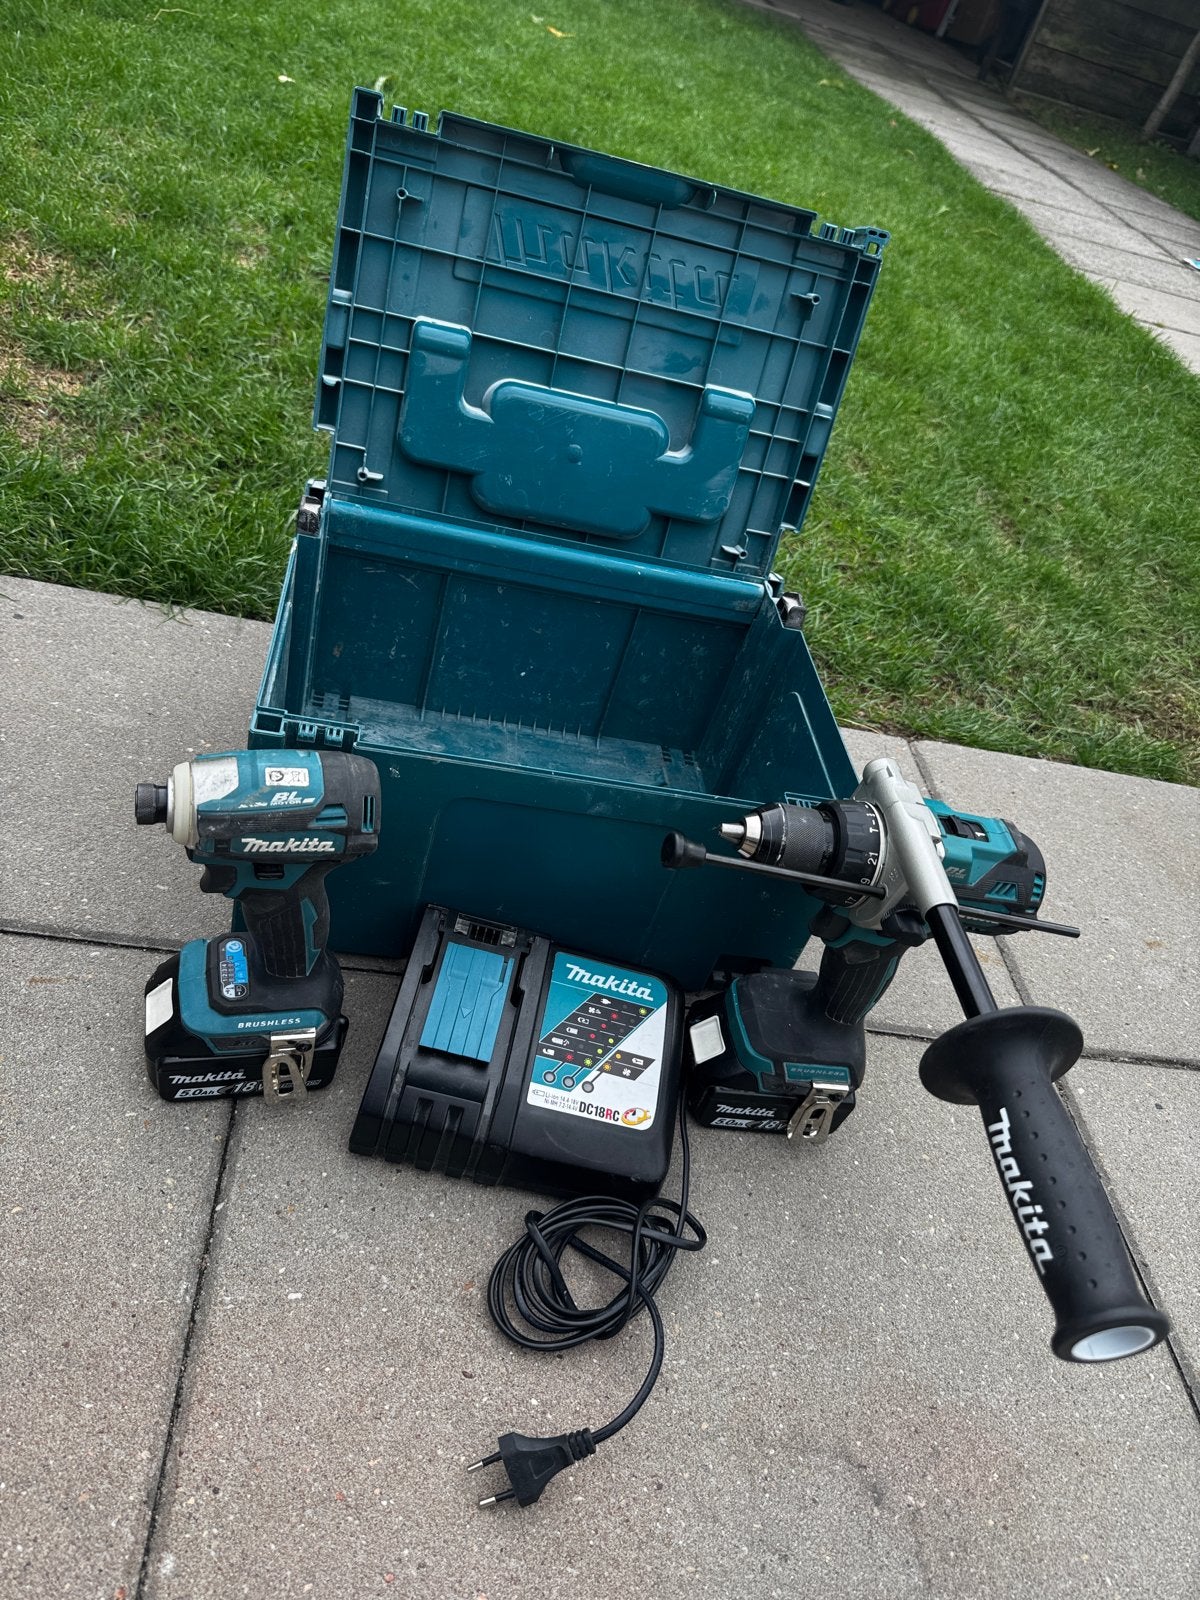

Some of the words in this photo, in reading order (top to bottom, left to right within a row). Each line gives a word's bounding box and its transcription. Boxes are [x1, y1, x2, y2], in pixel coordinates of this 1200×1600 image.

[271, 791, 302, 802] BL
[867, 851, 879, 866] 21
[860, 877, 871, 885] 9
[237, 1017, 301, 1029] BRUSHLESS
[579, 1101, 620, 1122] DC18RC
